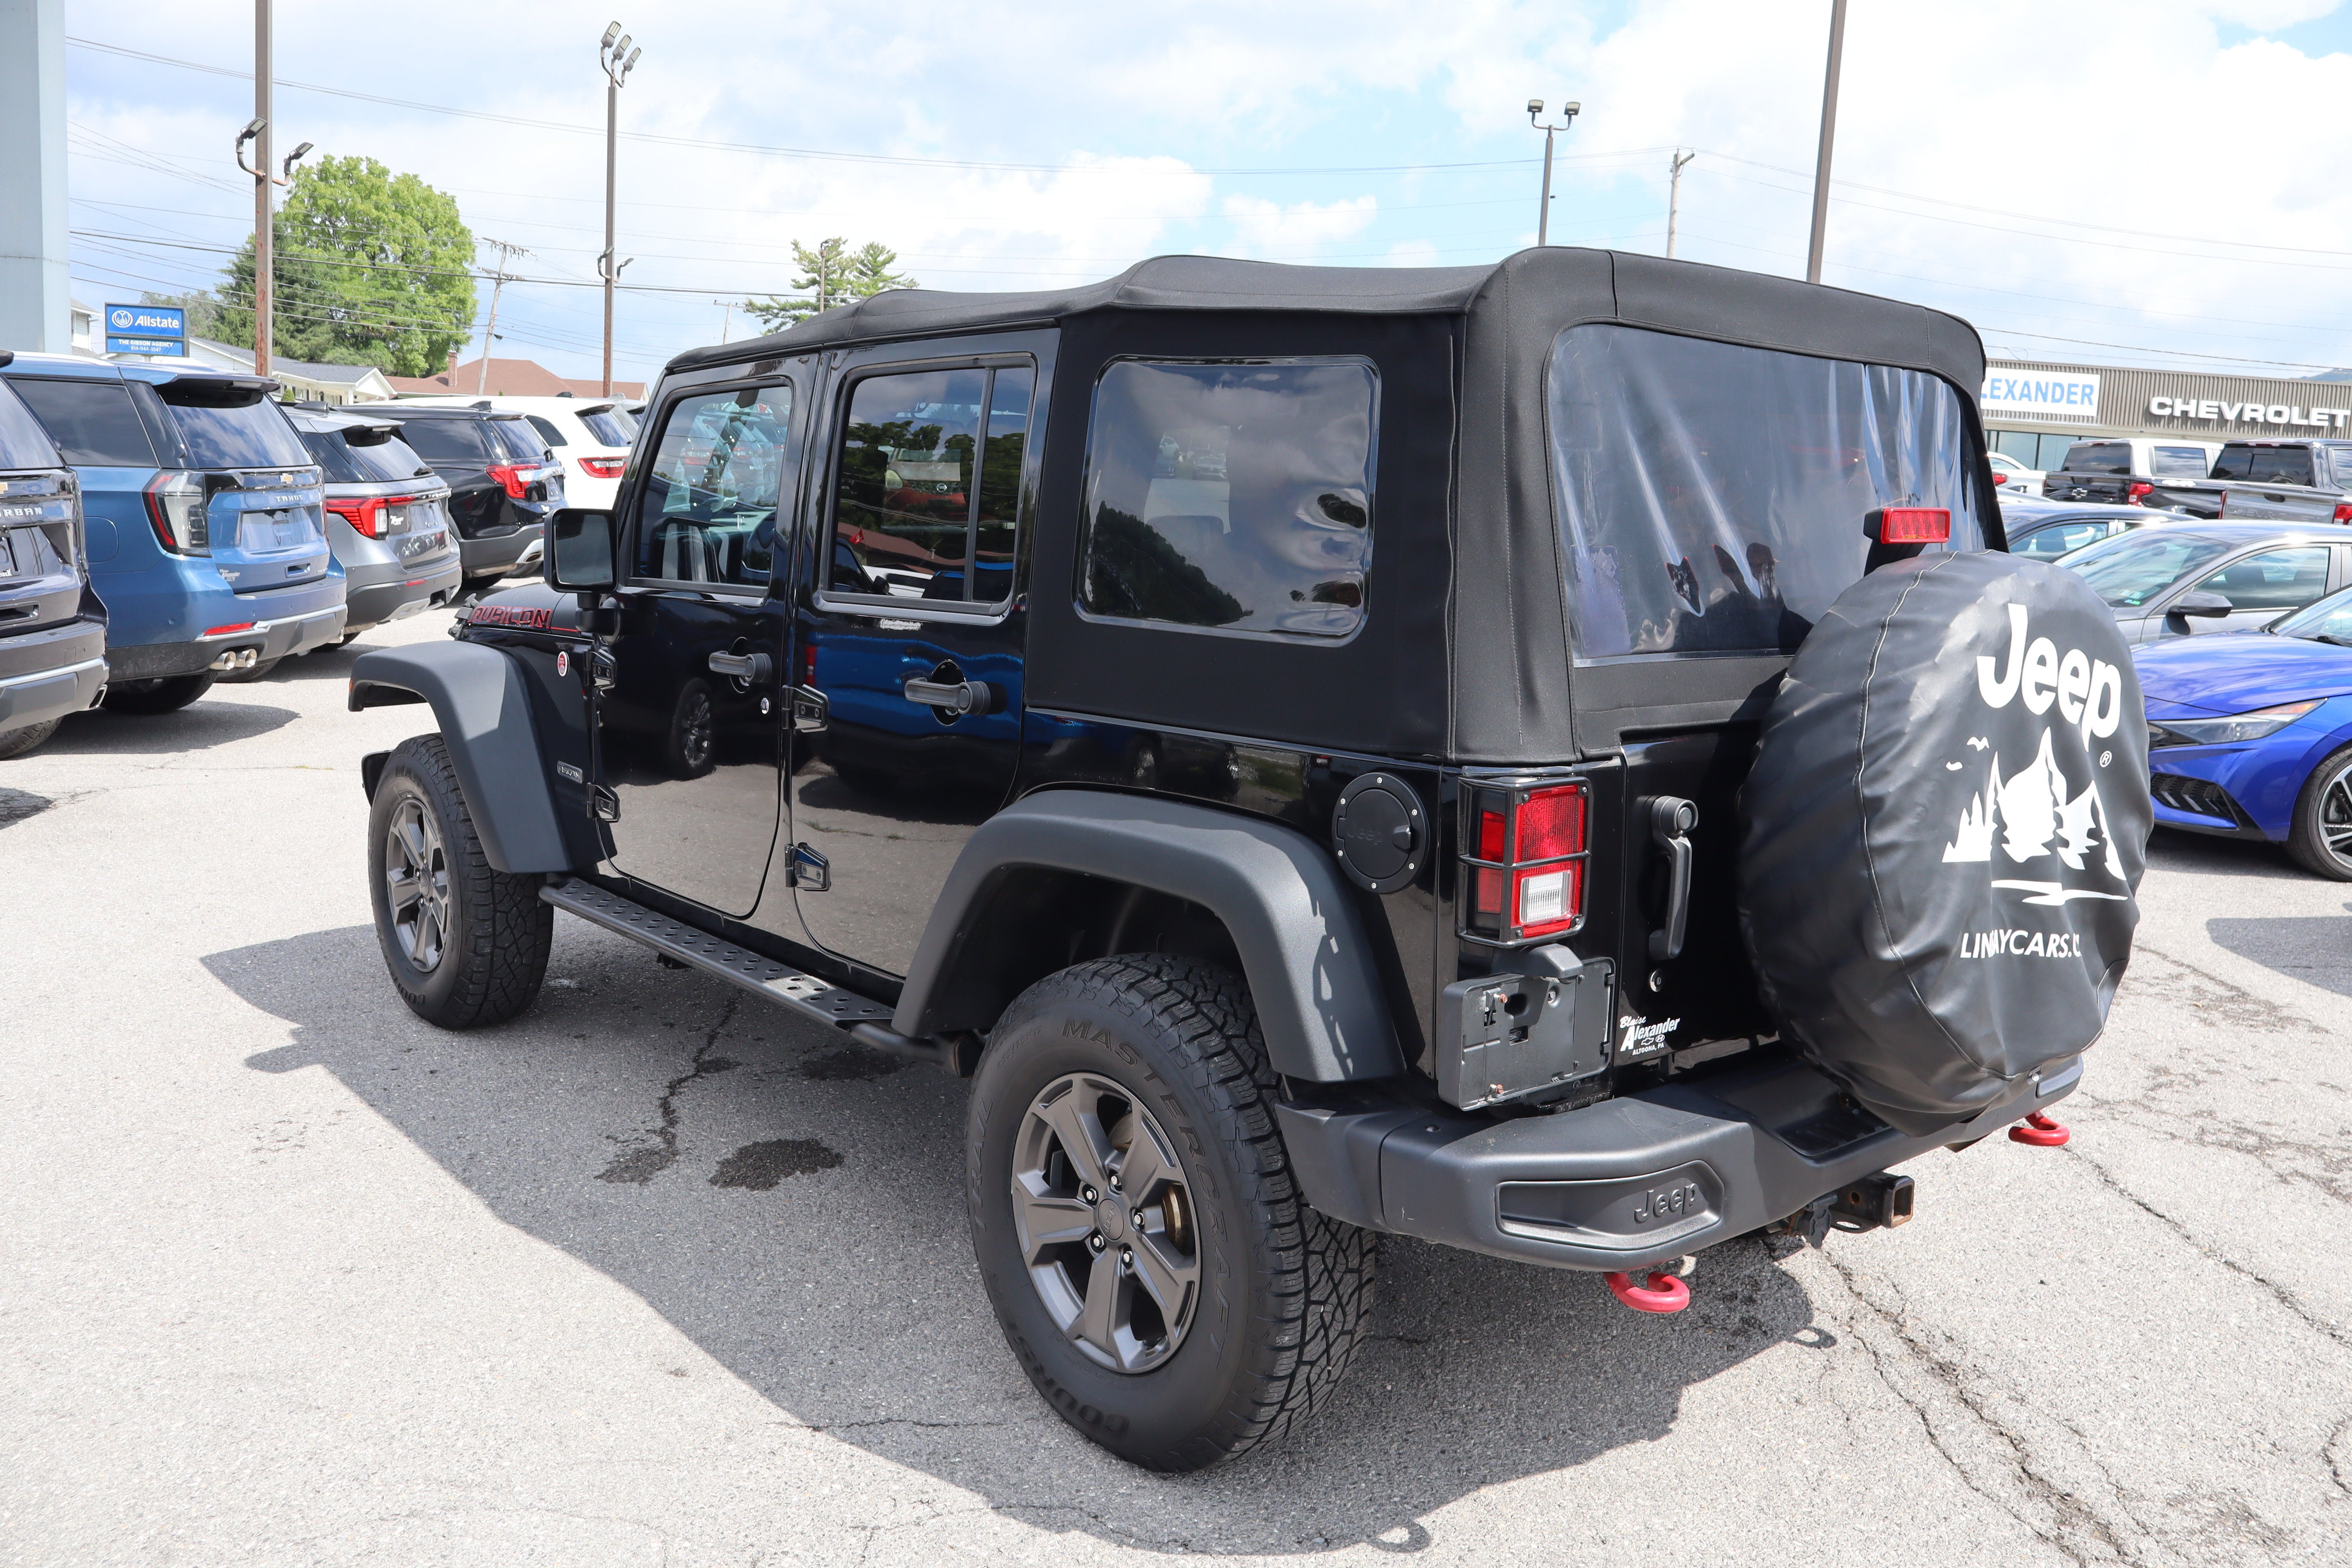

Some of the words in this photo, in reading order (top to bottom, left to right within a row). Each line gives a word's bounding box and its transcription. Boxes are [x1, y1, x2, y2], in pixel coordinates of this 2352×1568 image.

[135, 315, 179, 328] Allstate
[1981, 378, 2094, 405] EXANDER
[2149, 396, 2351, 428] CHEVROLET
[0, 507, 43, 517] RBAN
[467, 606, 552, 629] RUBICON
[1976, 603, 2122, 753] Jeep
[1347, 821, 1382, 845] Jeep
[1619, 1015, 1646, 1029] Blaise
[1620, 1017, 1681, 1052] Alexander
[1632, 1044, 1657, 1056] ALTOONA,
[1634, 1183, 1699, 1224] Jeep
[1104, 1205, 1115, 1234] Jeep
